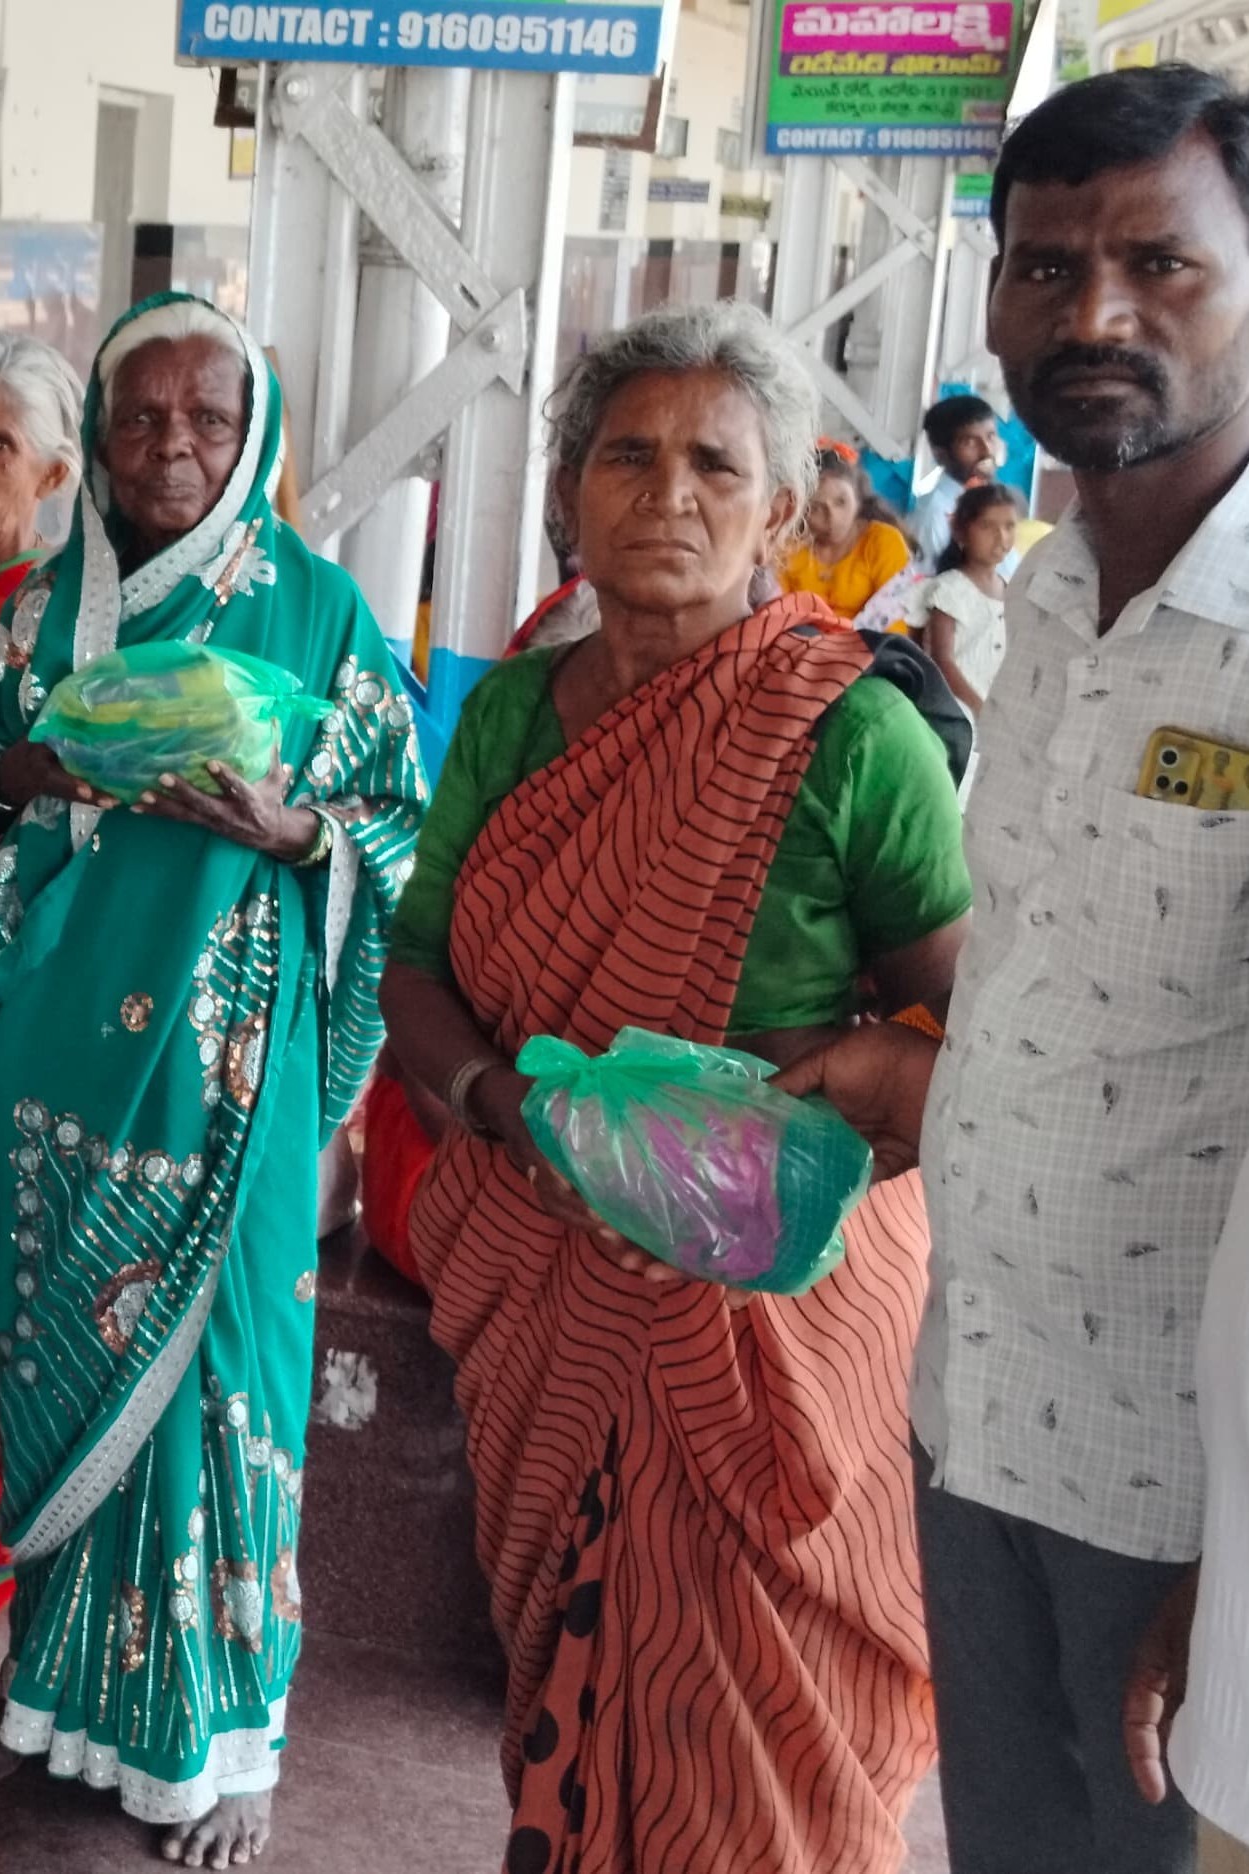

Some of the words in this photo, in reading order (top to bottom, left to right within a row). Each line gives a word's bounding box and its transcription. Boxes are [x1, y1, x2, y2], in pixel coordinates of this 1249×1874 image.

[203, 4, 373, 46] CONTACT
[397, 11, 637, 58] 9160951146
[777, 127, 865, 148] CONTACT
